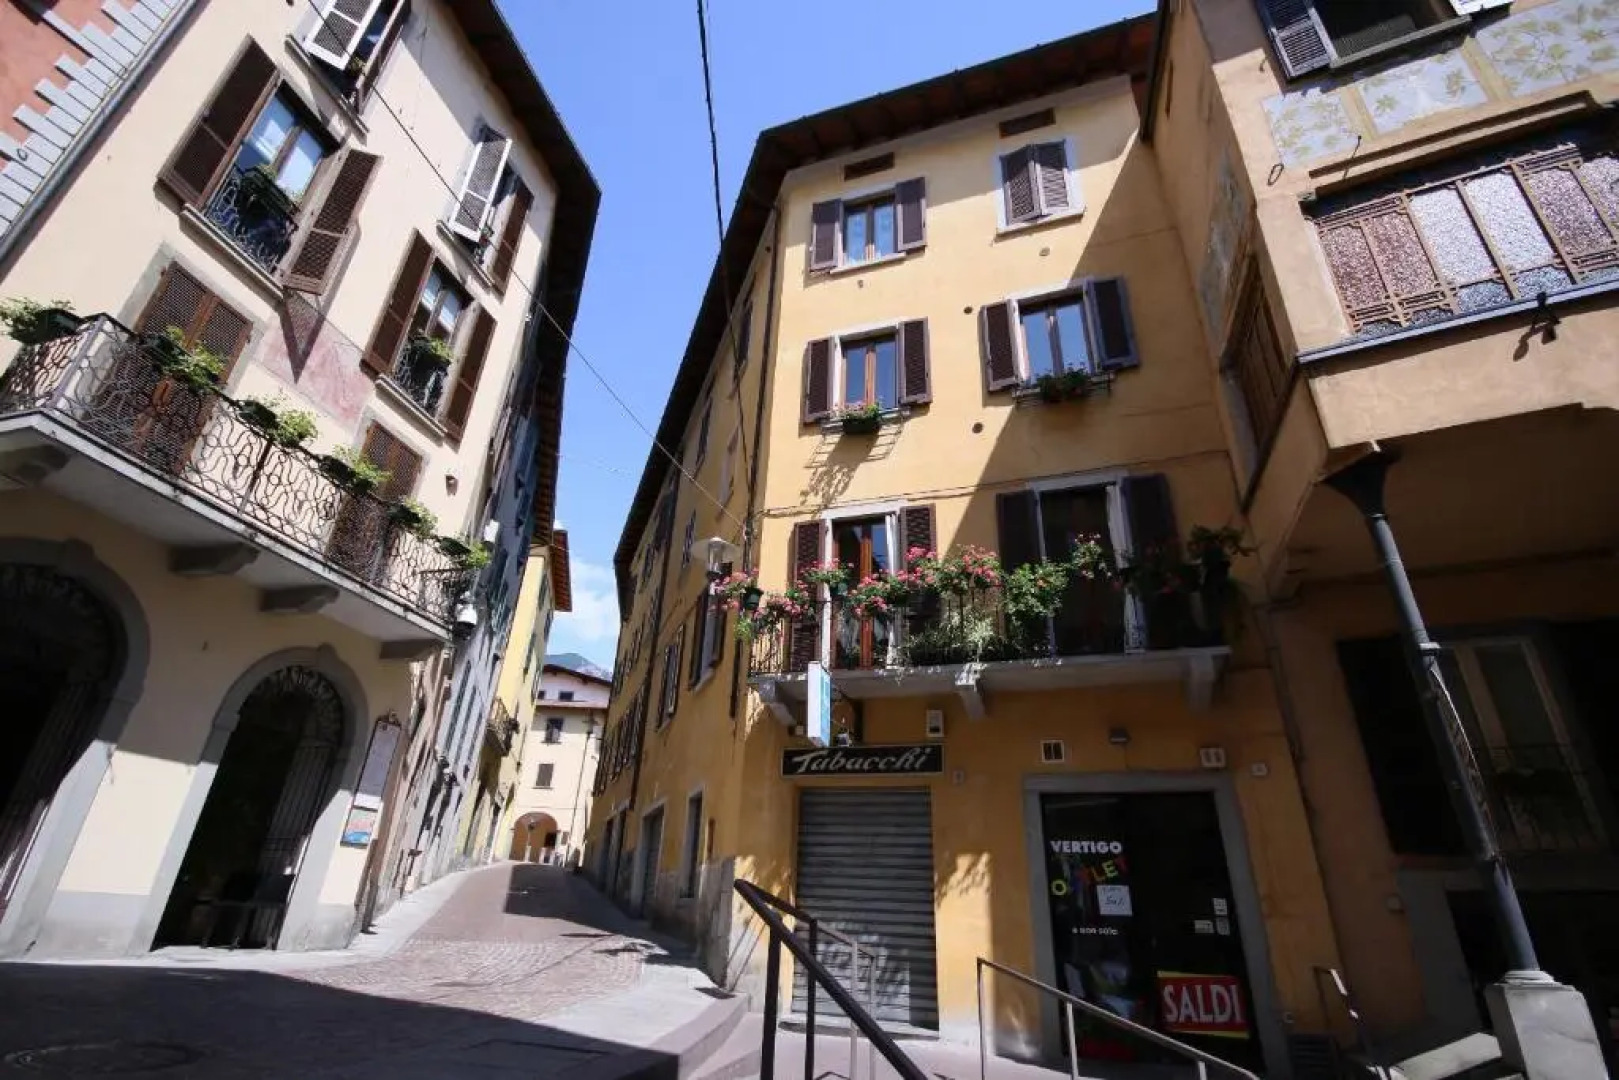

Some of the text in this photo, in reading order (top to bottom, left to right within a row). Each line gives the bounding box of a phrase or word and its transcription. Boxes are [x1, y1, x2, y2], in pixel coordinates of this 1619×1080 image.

[792, 747, 932, 774] Tabacchi
[1051, 840, 1122, 854] VERTIGO
[1163, 984, 1242, 1024] SALDI
